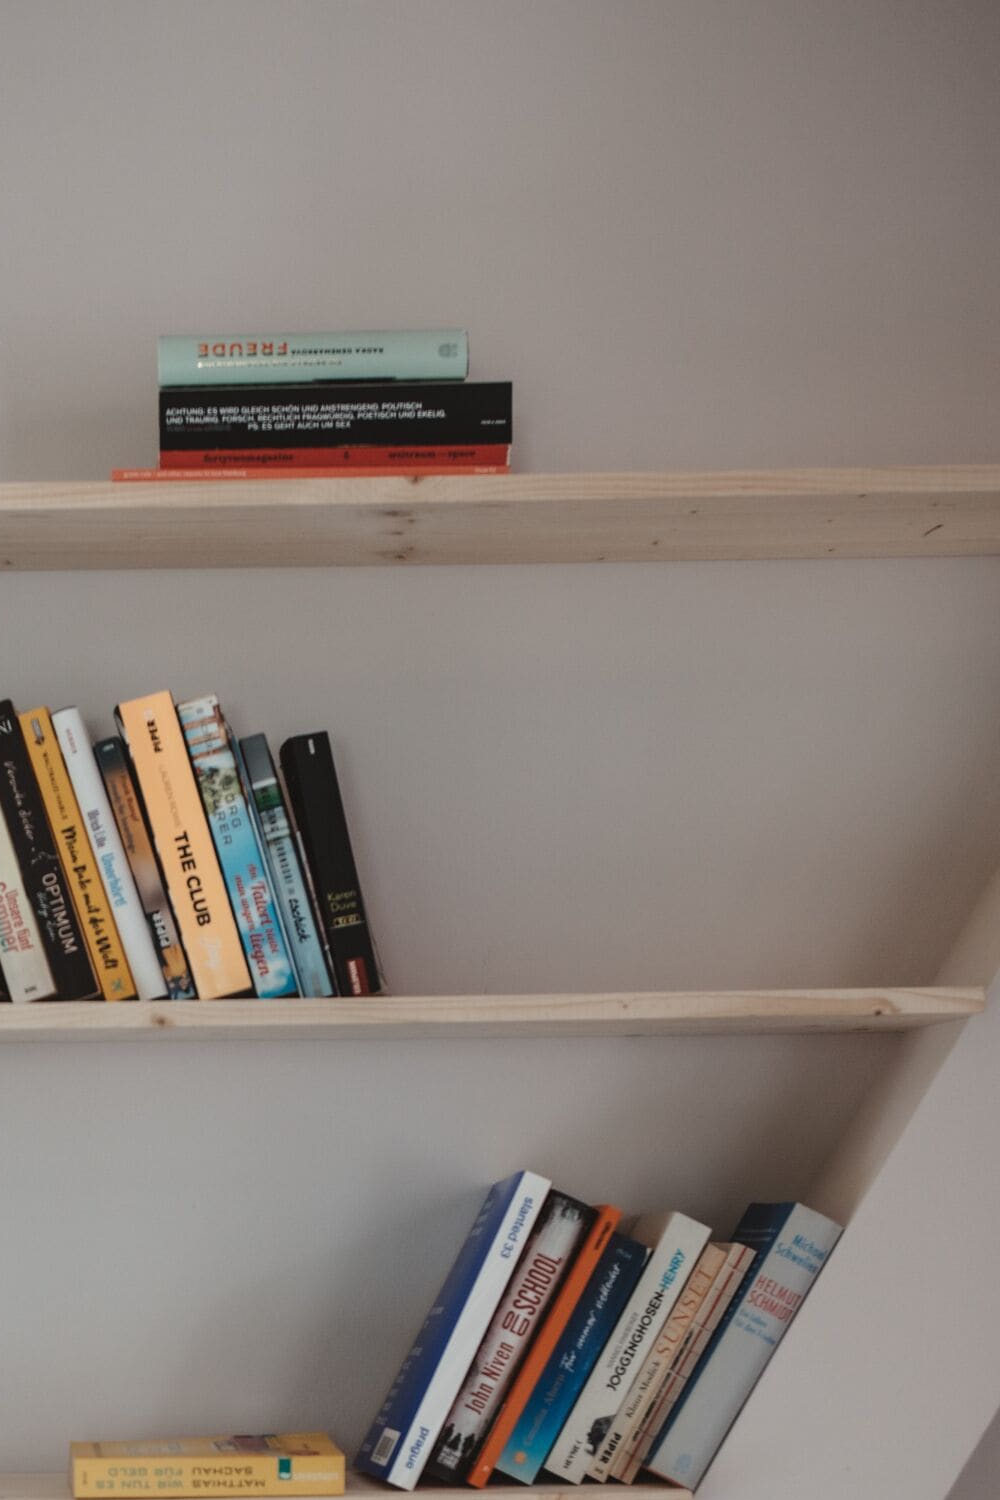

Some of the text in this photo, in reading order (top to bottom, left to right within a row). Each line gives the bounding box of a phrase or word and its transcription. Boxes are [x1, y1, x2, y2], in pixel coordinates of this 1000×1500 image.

[196, 342, 288, 357] FREUDE
[241, 404, 269, 413] GLEICH
[145, 718, 163, 753] PIPER
[172, 829, 212, 928] THE CLUB
[3, 888, 26, 927] Unsere
[39, 870, 78, 956] OPTIMUM
[248, 880, 274, 928] Tatort
[246, 931, 273, 979] liegen
[497, 1195, 536, 1261] slanted 33
[510, 1247, 562, 1318] SCHOOL
[750, 1289, 796, 1323] SCHMIDT
[755, 1275, 802, 1306] HELMUT
[604, 1247, 688, 1393] JOGGINGHOSEN-HENRY
[654, 1261, 717, 1359] SUNSET
[463, 1337, 515, 1416] John Niven
[401, 1425, 432, 1471] prague
[599, 1431, 623, 1465] PIPER
[191, 1480, 266, 1489] MATTHIAS
